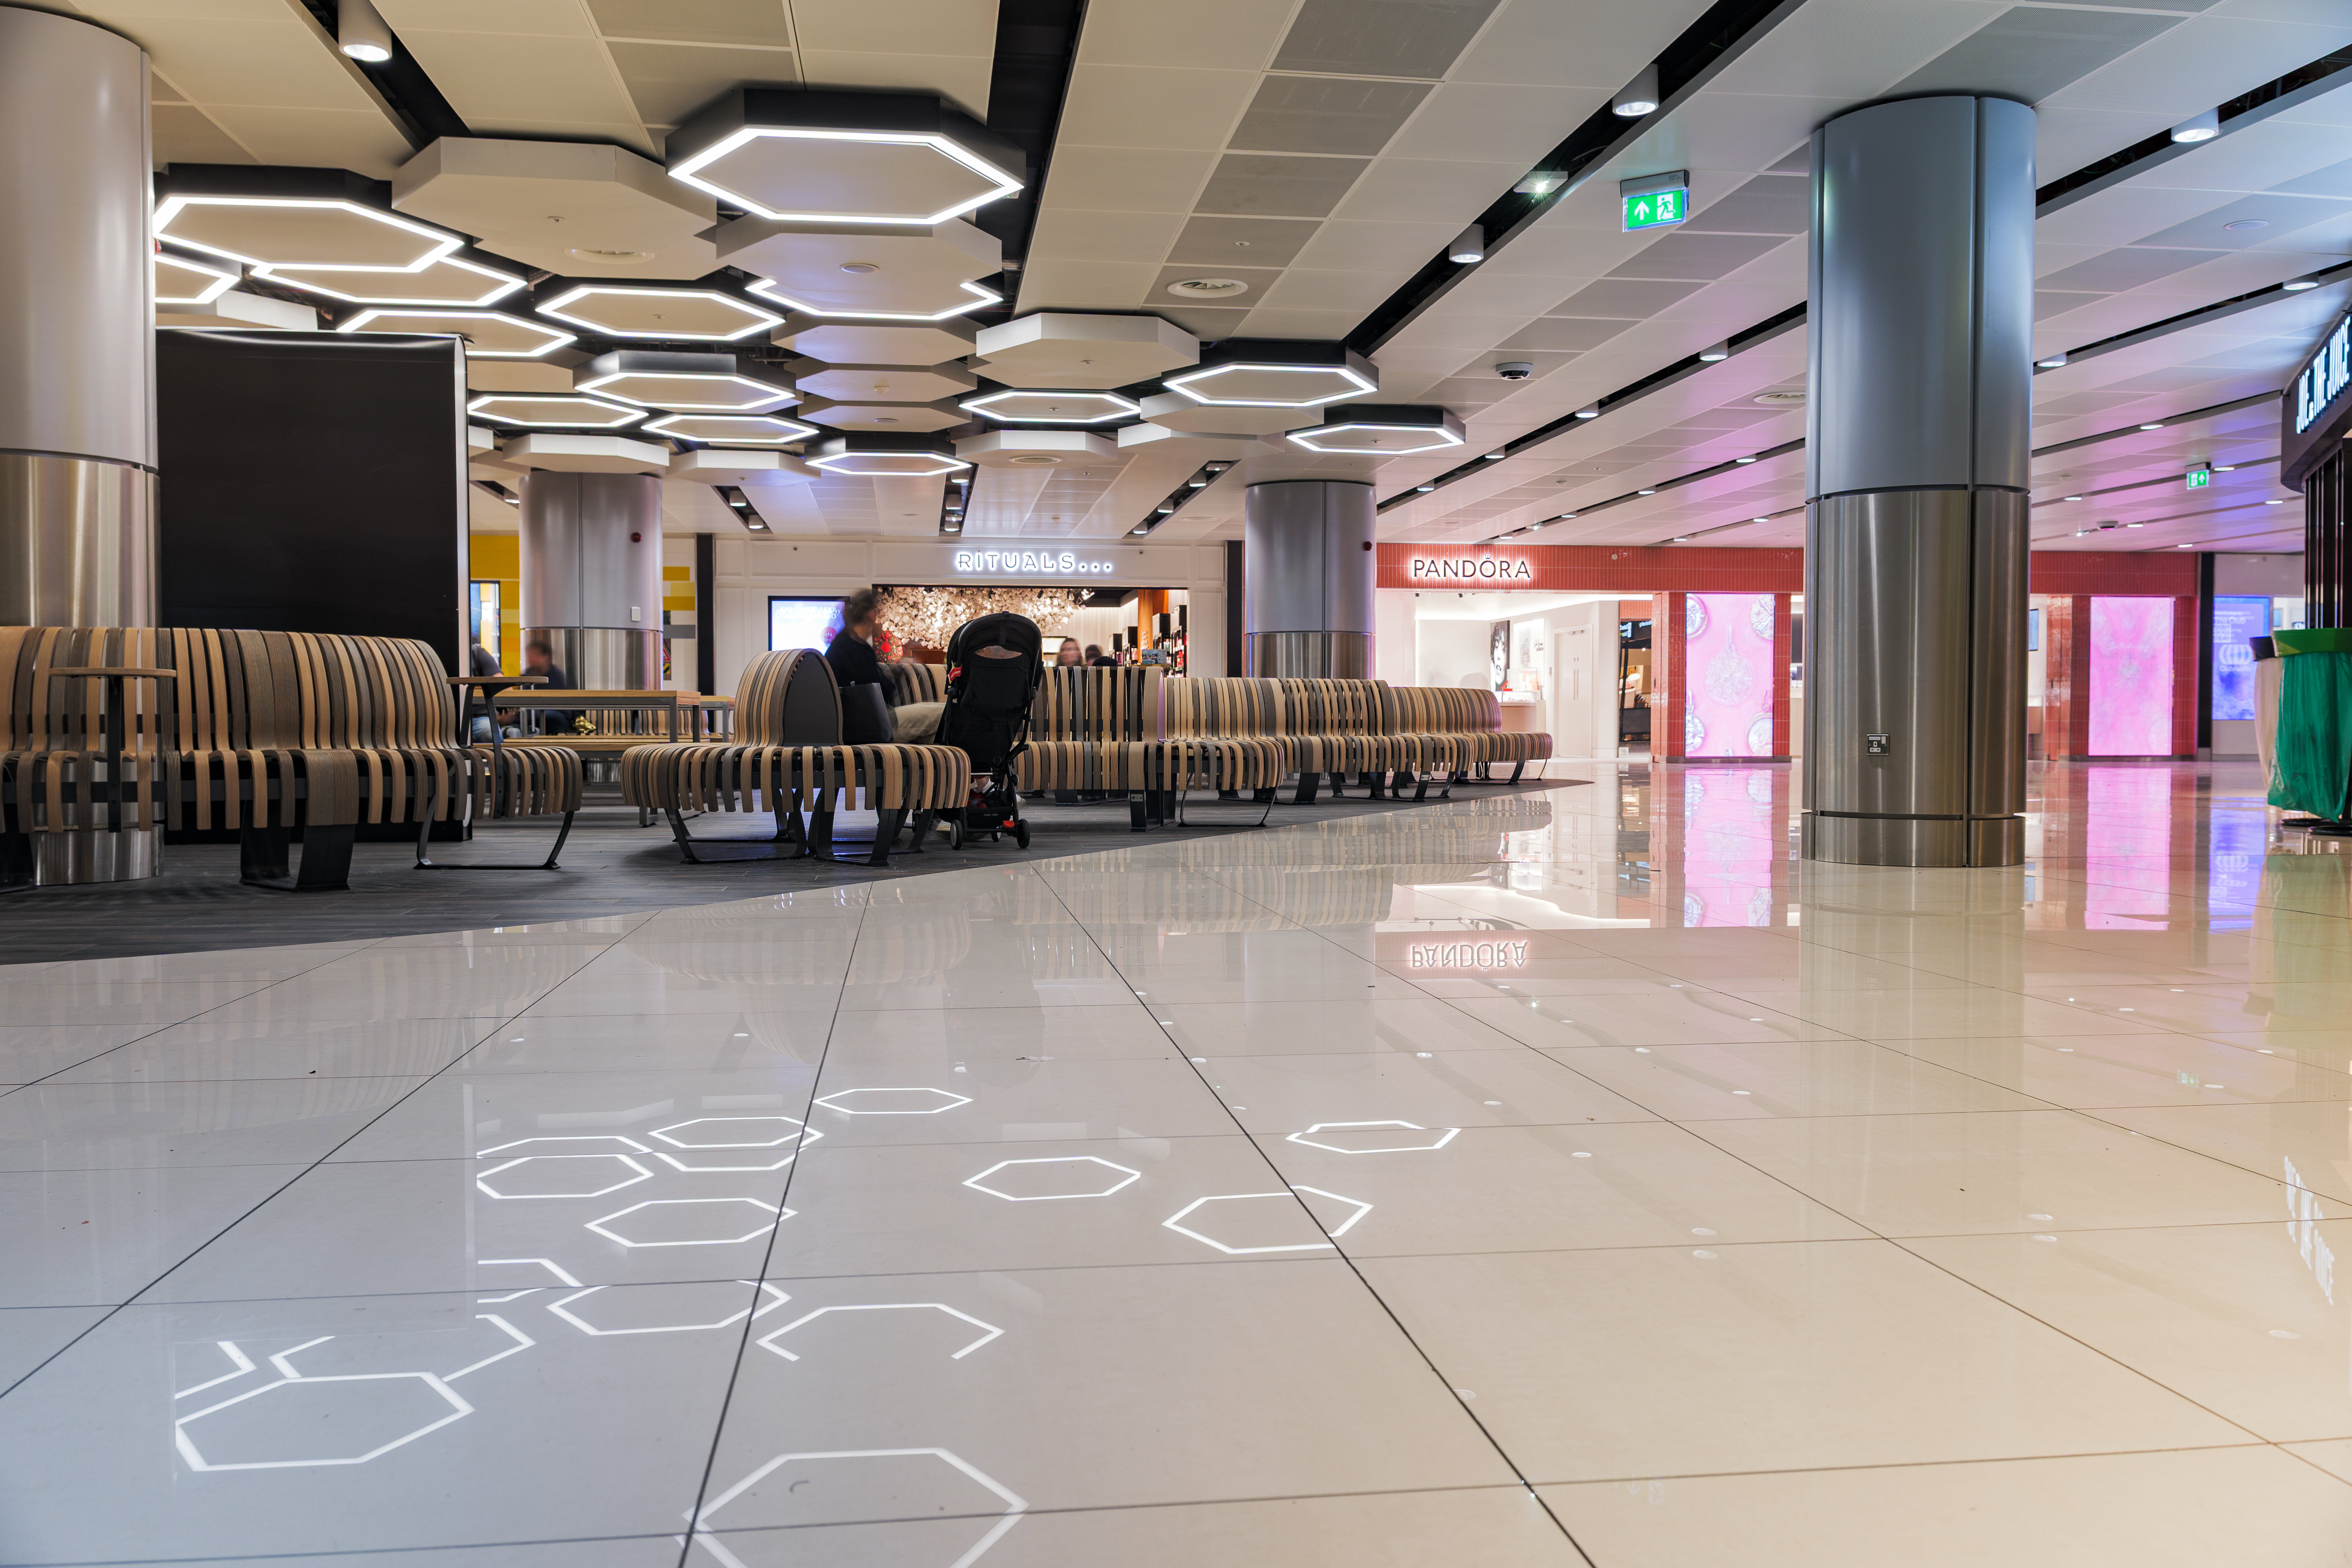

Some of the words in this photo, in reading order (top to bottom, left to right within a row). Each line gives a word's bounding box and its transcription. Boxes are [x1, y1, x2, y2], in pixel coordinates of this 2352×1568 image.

[2296, 368, 2310, 434] JOE
[2313, 346, 2327, 417] THE
[2327, 316, 2350, 401] JUICE
[1414, 560, 1530, 578] PANDORA
